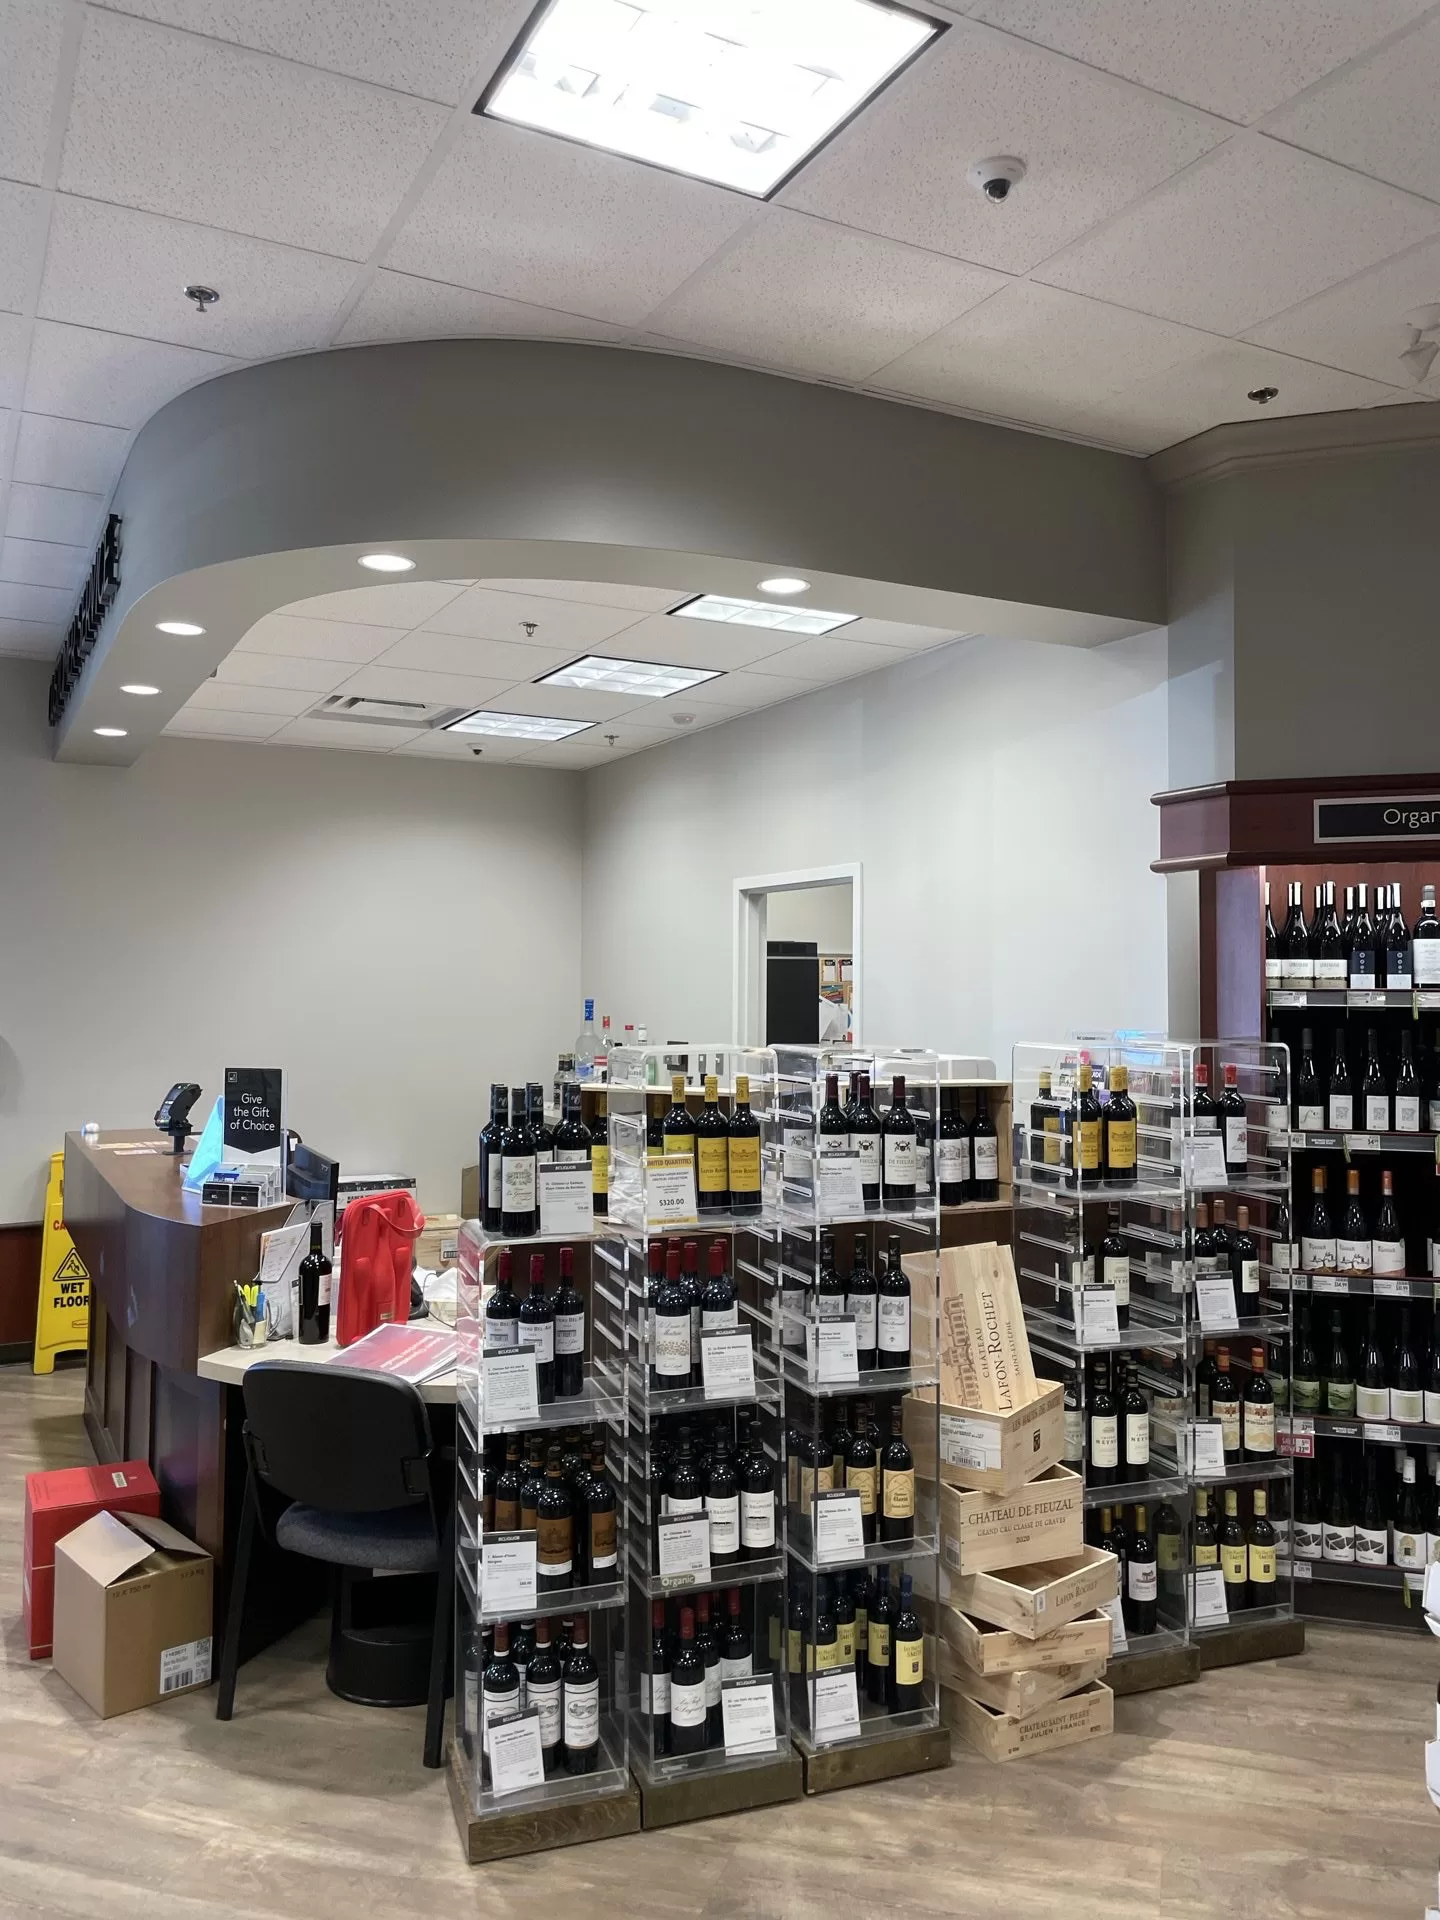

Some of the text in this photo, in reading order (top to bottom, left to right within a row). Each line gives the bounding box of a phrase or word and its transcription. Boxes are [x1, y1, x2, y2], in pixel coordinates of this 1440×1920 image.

[241, 1093, 262, 1104] Give
[234, 1106, 270, 1118] the Gift
[230, 1120, 276, 1131] of Choice
[61, 1282, 84, 1294] WET
[969, 1499, 1074, 1525] CHATEAU DE FIEUZAL
[978, 1528, 998, 1536] GRAND
[1044, 1517, 1066, 1526] GRAVES
[662, 1575, 695, 1587] Organic
[1030, 1728, 1054, 1739] JULIEN
